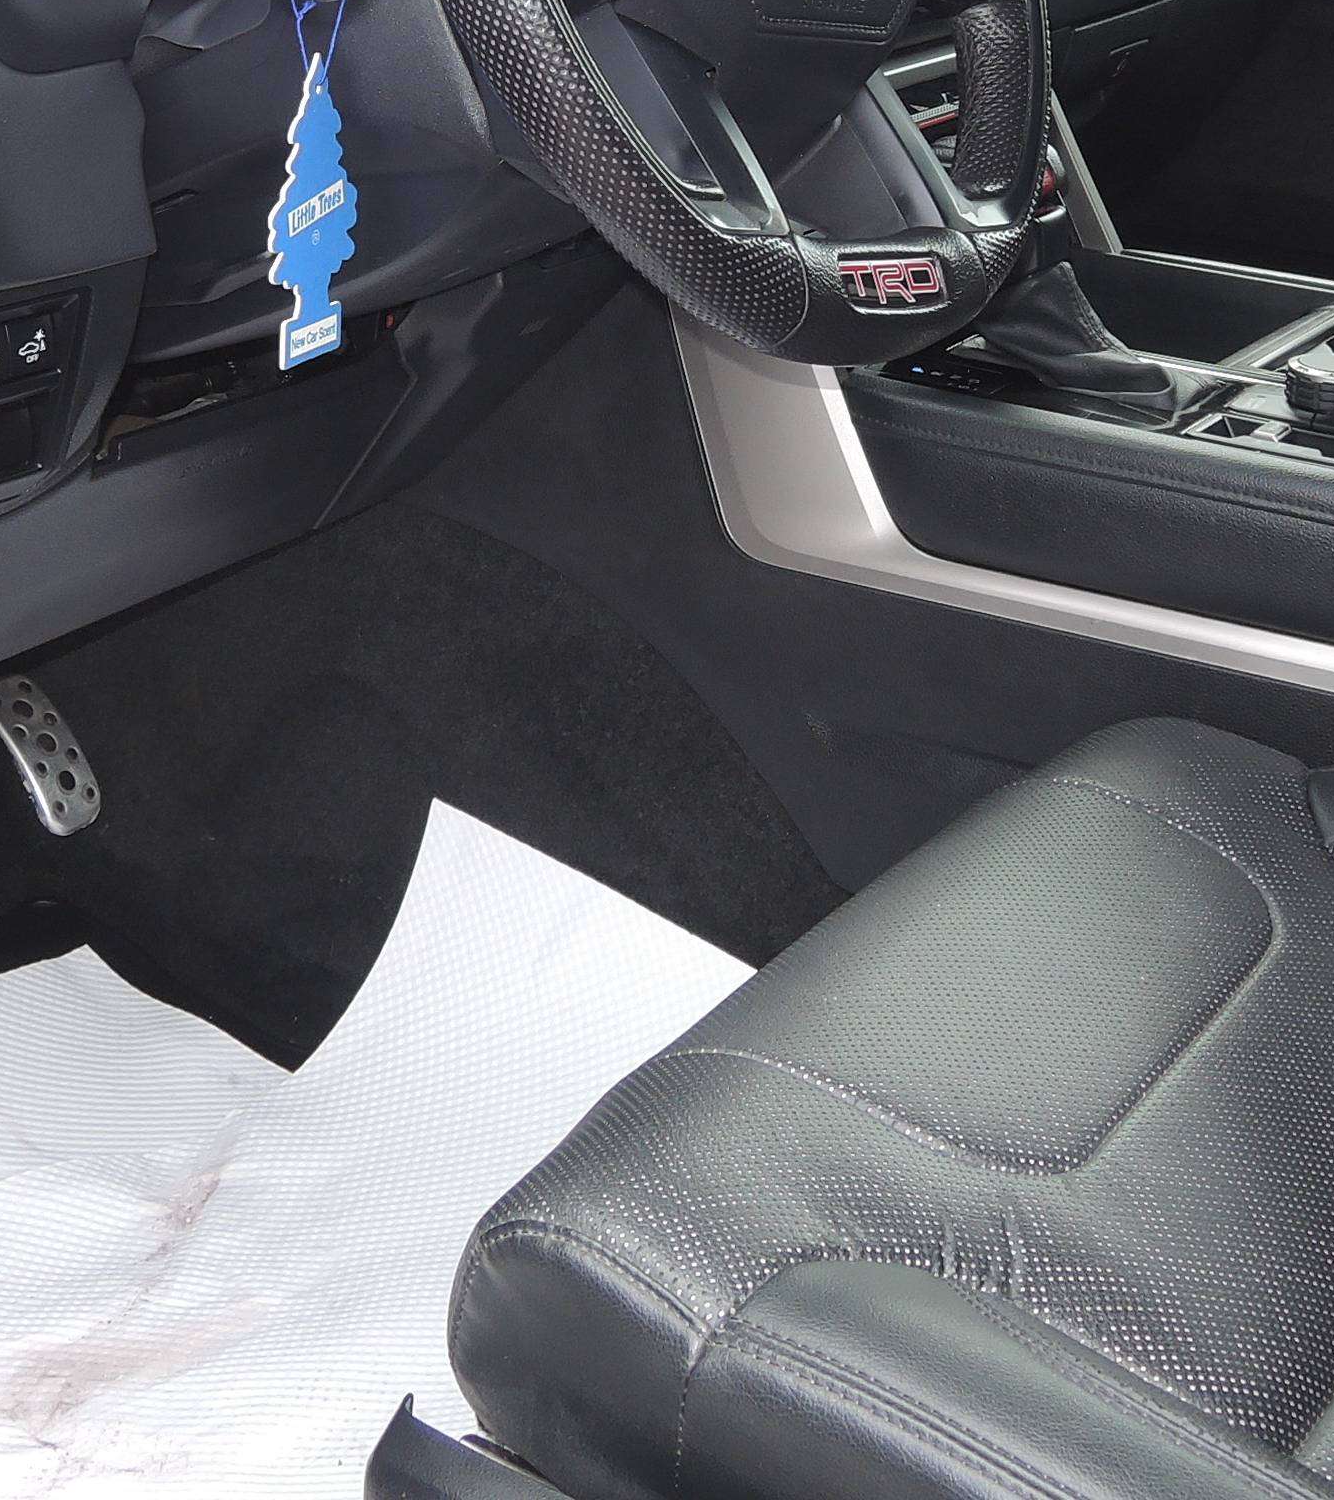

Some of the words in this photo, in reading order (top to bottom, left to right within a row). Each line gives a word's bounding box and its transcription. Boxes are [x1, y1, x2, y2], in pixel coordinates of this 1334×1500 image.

[291, 201, 316, 234] Little
[318, 188, 342, 215] Trees
[837, 257, 941, 305] TRD
[291, 336, 306, 352] New
[306, 331, 318, 344] Car
[318, 324, 336, 339] Scent
[25, 353, 40, 364] OFF
